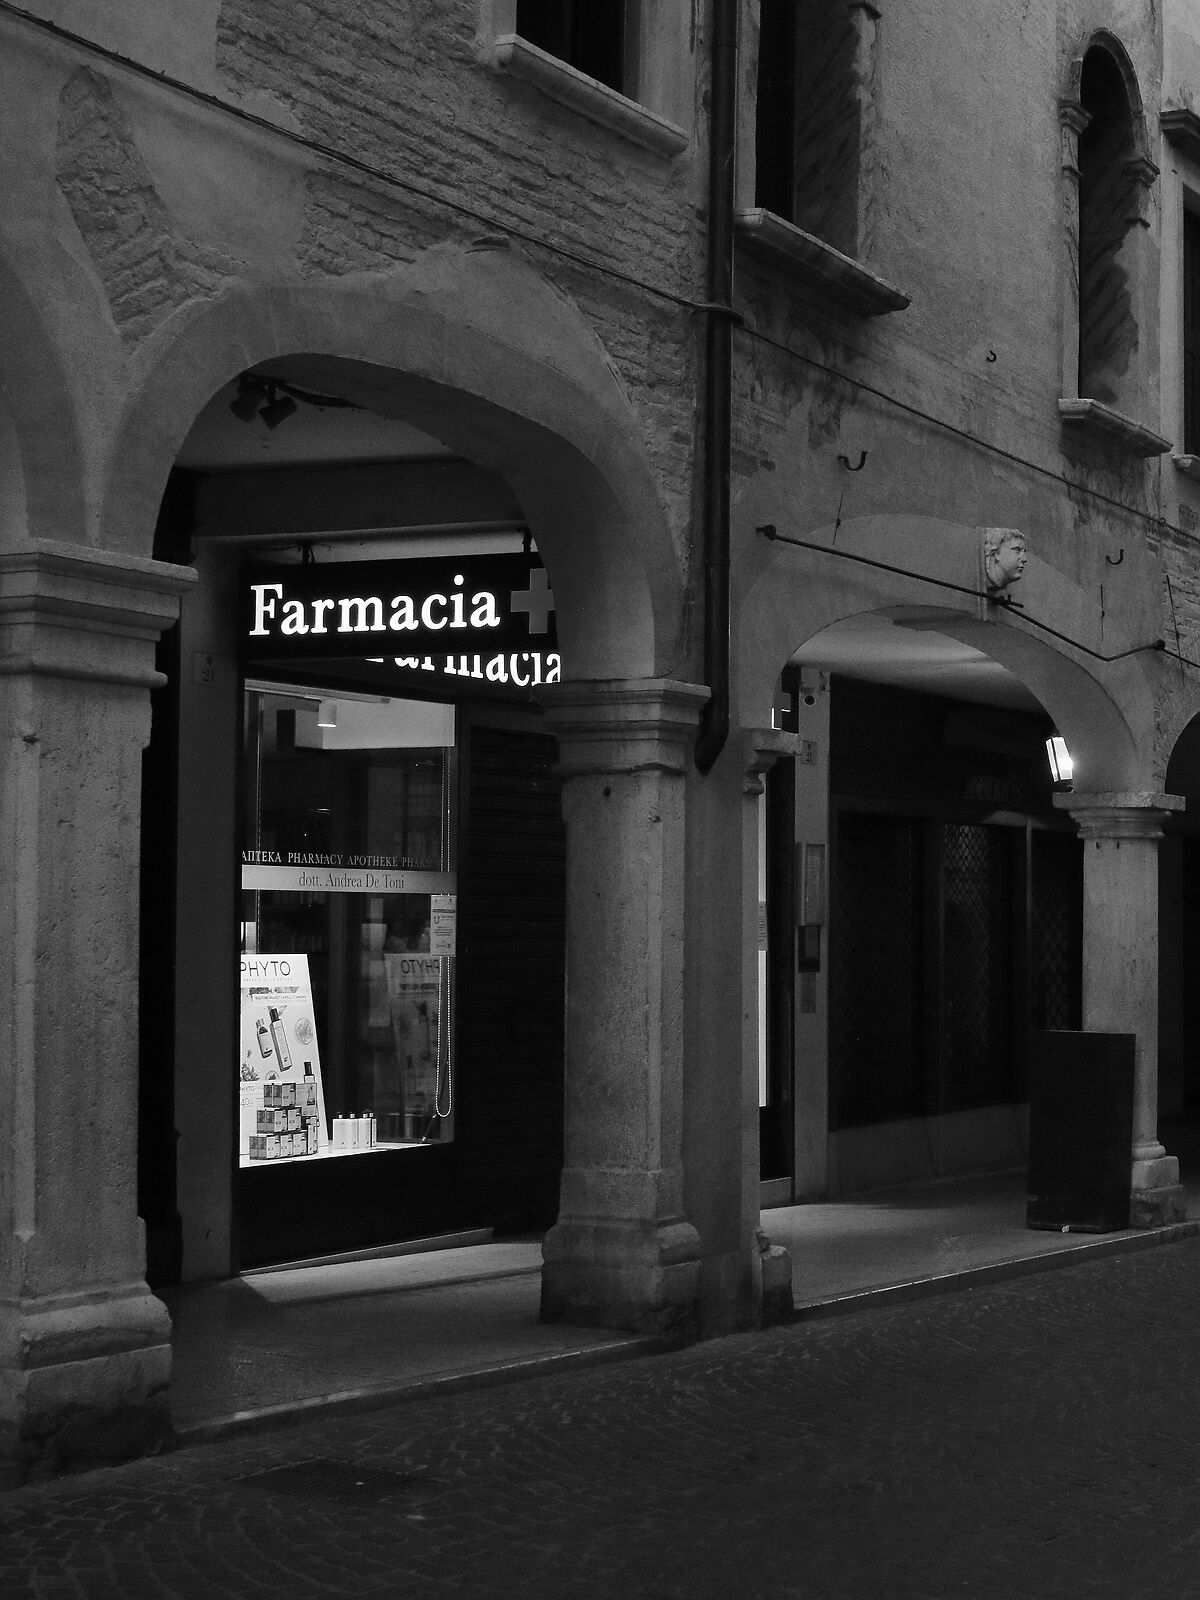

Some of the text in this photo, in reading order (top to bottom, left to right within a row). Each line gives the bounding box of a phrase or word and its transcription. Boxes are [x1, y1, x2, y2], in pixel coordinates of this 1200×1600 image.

[249, 575, 501, 636] Farmacia
[287, 852, 343, 865] PHARMACY
[347, 855, 398, 867] APOTHEKE
[298, 872, 405, 889] dott. Andrea De Toni
[241, 960, 291, 977] PHYTO
